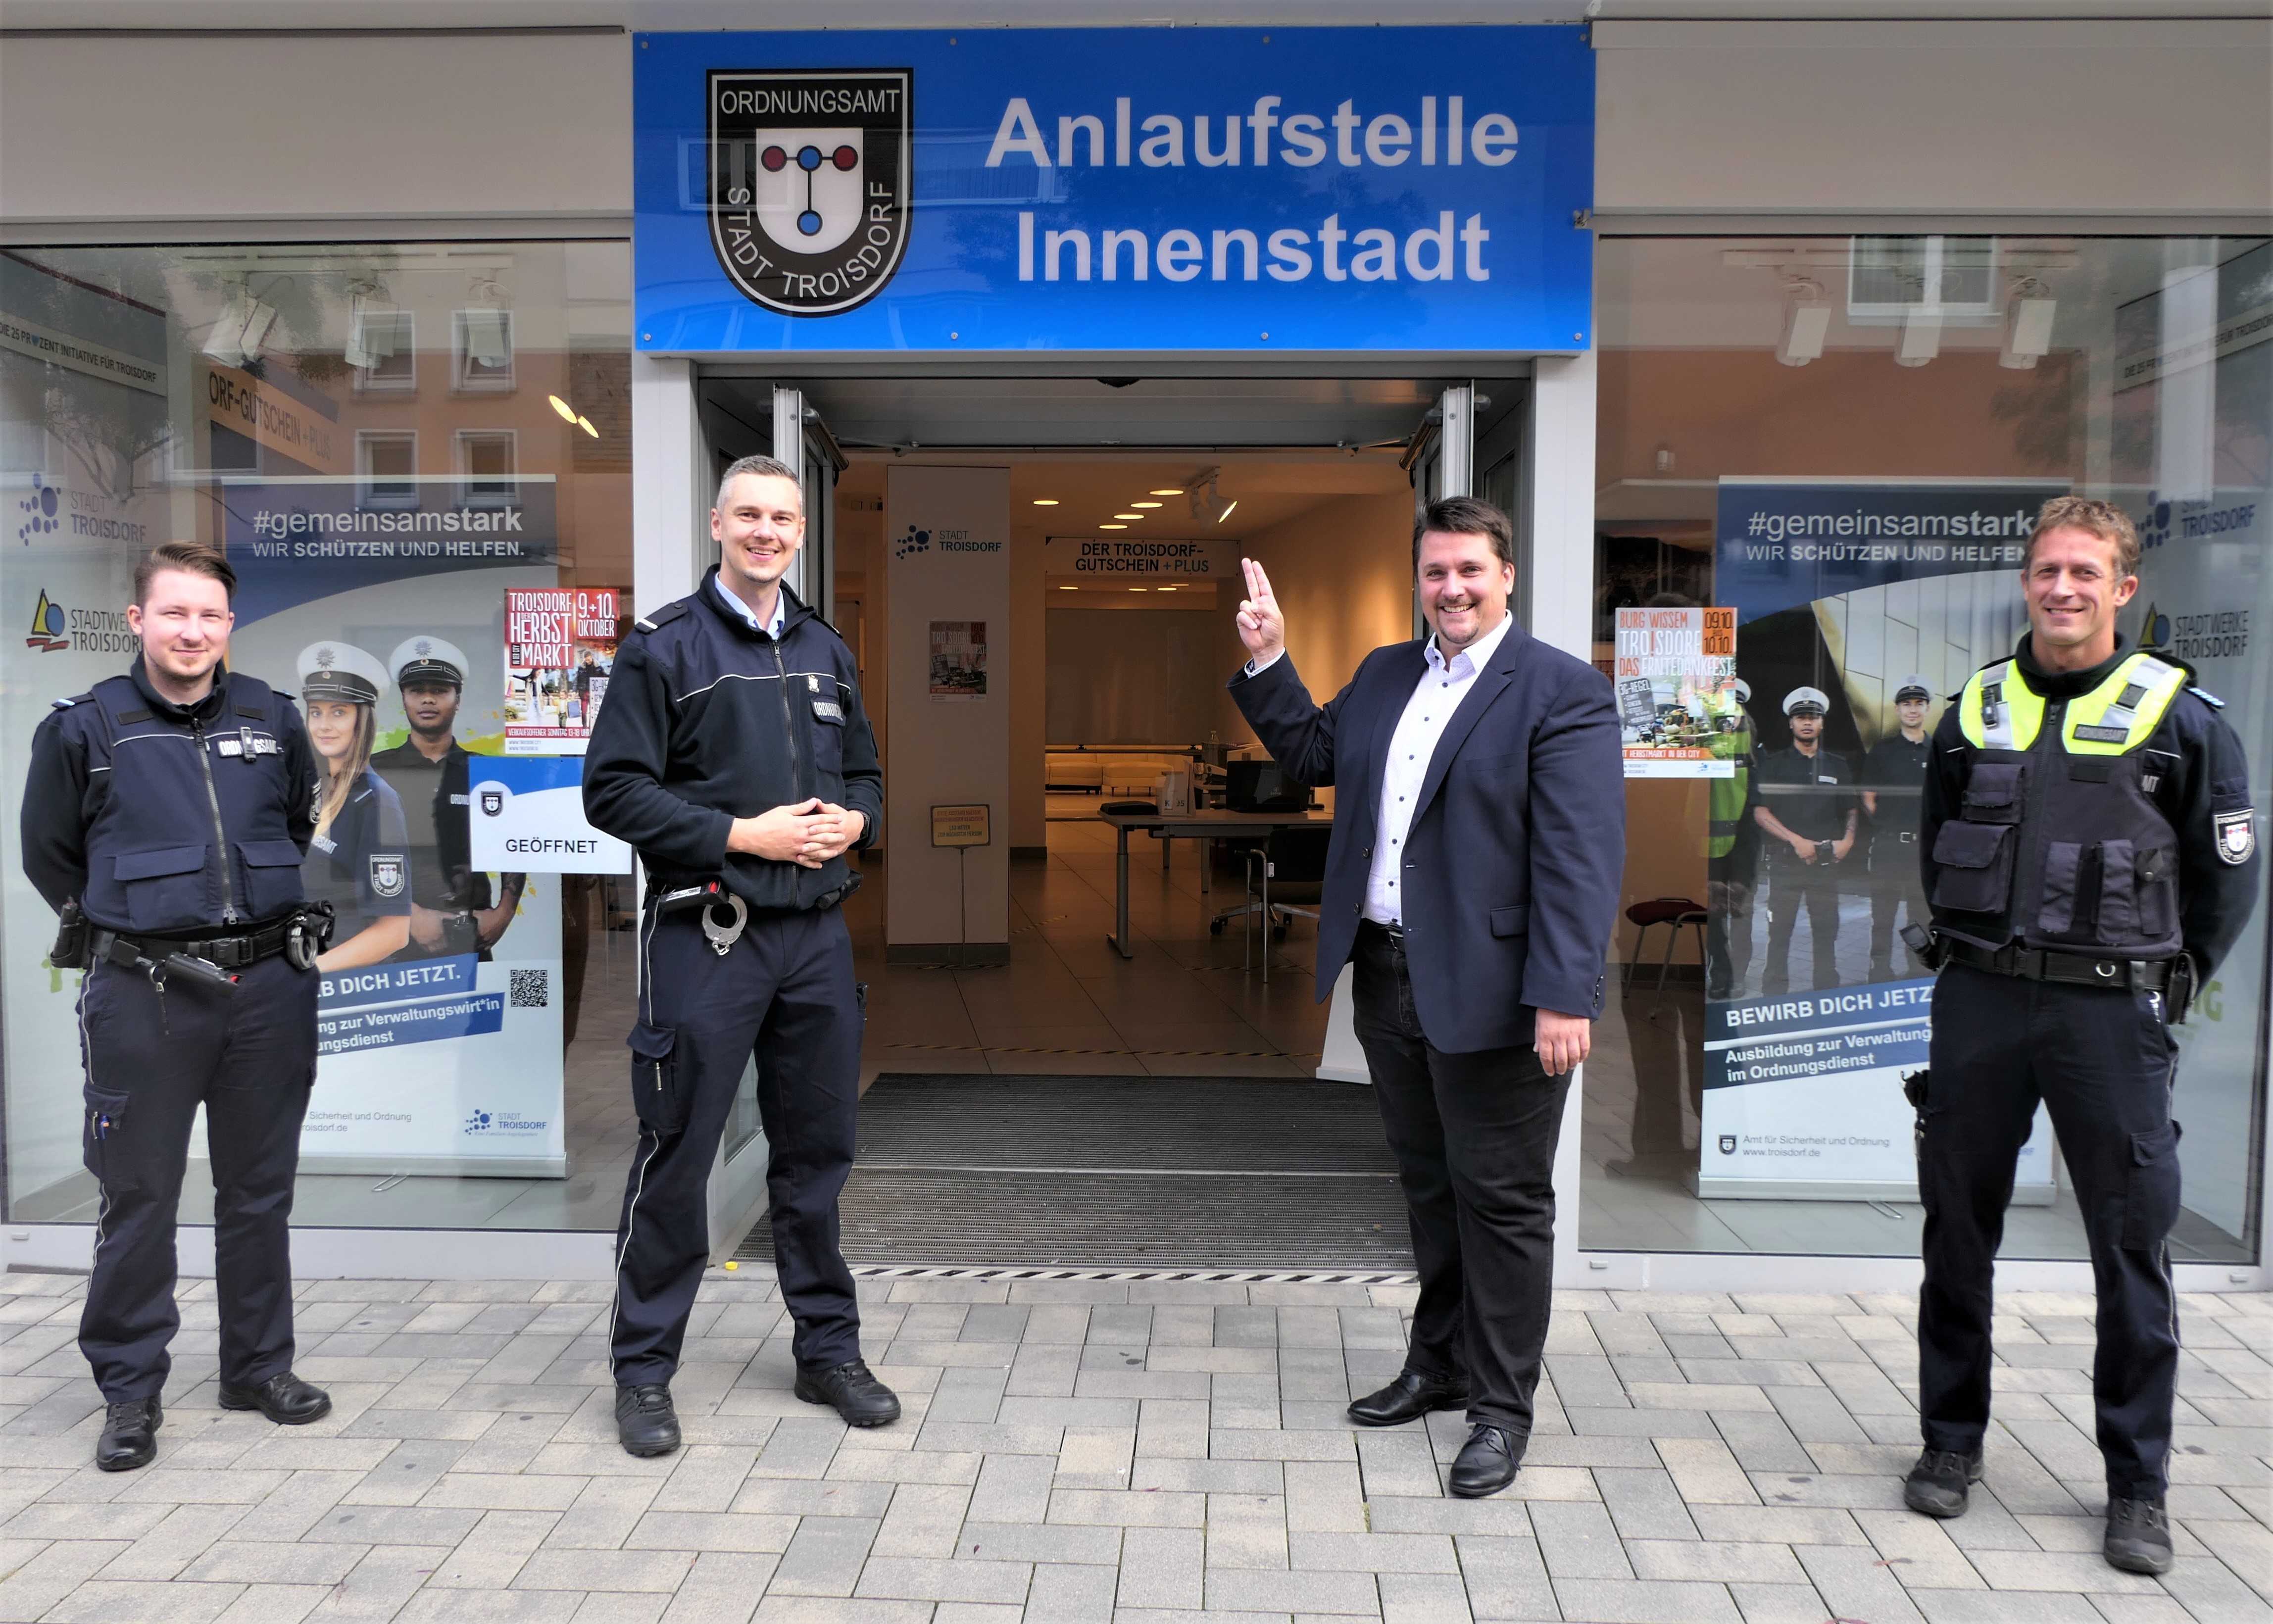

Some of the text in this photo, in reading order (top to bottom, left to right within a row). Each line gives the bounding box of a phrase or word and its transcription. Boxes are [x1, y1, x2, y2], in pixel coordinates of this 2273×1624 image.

[721, 89, 900, 114] ORDNUNGSAMT
[985, 95, 1519, 168] Anlaufstelle
[728, 181, 893, 298] STADT TROISDORF
[1018, 210, 1491, 282] Innenstadt
[11, 327, 20, 340] 25
[61, 344, 99, 366] INITIATIVE
[100, 354, 115, 370] FÜR
[116, 361, 157, 383] TROISDORF
[71, 491, 106, 513] STADT
[71, 513, 147, 543] TROISDORF
[253, 506, 523, 540] #gemeinsamstark
[1748, 509, 2034, 542] #gemeinsamstark
[2181, 504, 2256, 538] TROISDORF
[939, 530, 969, 540] STADT
[939, 541, 1002, 552] TROISDORF
[253, 539, 524, 557] WIR SCHÜTZEN UND HELFEN.
[1082, 542, 1204, 557] DER TROISDORF-
[1746, 546, 1784, 561] WIR
[1790, 542, 1897, 561] SCHÜTZEN
[1904, 546, 1945, 561] UND
[1075, 558, 1159, 572] GUTSCHEIN
[1174, 559, 1209, 572] PLUS
[71, 609, 130, 632] STADTWE
[510, 612, 615, 643] HERBST OKTOBER
[1619, 611, 1734, 629] BURG WISSEM 09.10.
[2175, 610, 2249, 637] STADTWERKE
[521, 643, 572, 667] MARKT
[1619, 630, 1732, 657] TRO!SDORF 10.10.
[2175, 634, 2248, 659] TROISDORF
[1619, 657, 1733, 677] DAS ERNTEDANKFEST
[508, 728, 546, 737] VERKAUFSOFFENER
[548, 728, 568, 737] SONNTAG
[581, 729, 590, 737] UHR
[1629, 749, 1667, 758] HERBSTMARKT
[1668, 749, 1675, 758] IN
[1676, 749, 1686, 758] DER
[1687, 749, 1701, 758] CITY
[506, 837, 598, 853] GEÖFFNET
[340, 972, 390, 995] DICH
[395, 964, 461, 987] JETZT.
[1726, 985, 1934, 1027] BEWIRB DICH JETZ
[340, 1019, 363, 1031] zur
[1725, 1042, 1814, 1064] Ausbildung
[1817, 1040, 1842, 1052] zur
[1727, 1052, 1875, 1082] im Ordnungsdienst
[309, 1111, 412, 1123] Sicherheit und Ordnung
[497, 1121, 547, 1130] TROISDORF
[1743, 1135, 1890, 1148] Amt für Sicherheit und Ordnung
[1743, 1148, 1821, 1157] www.troisdorf.de
